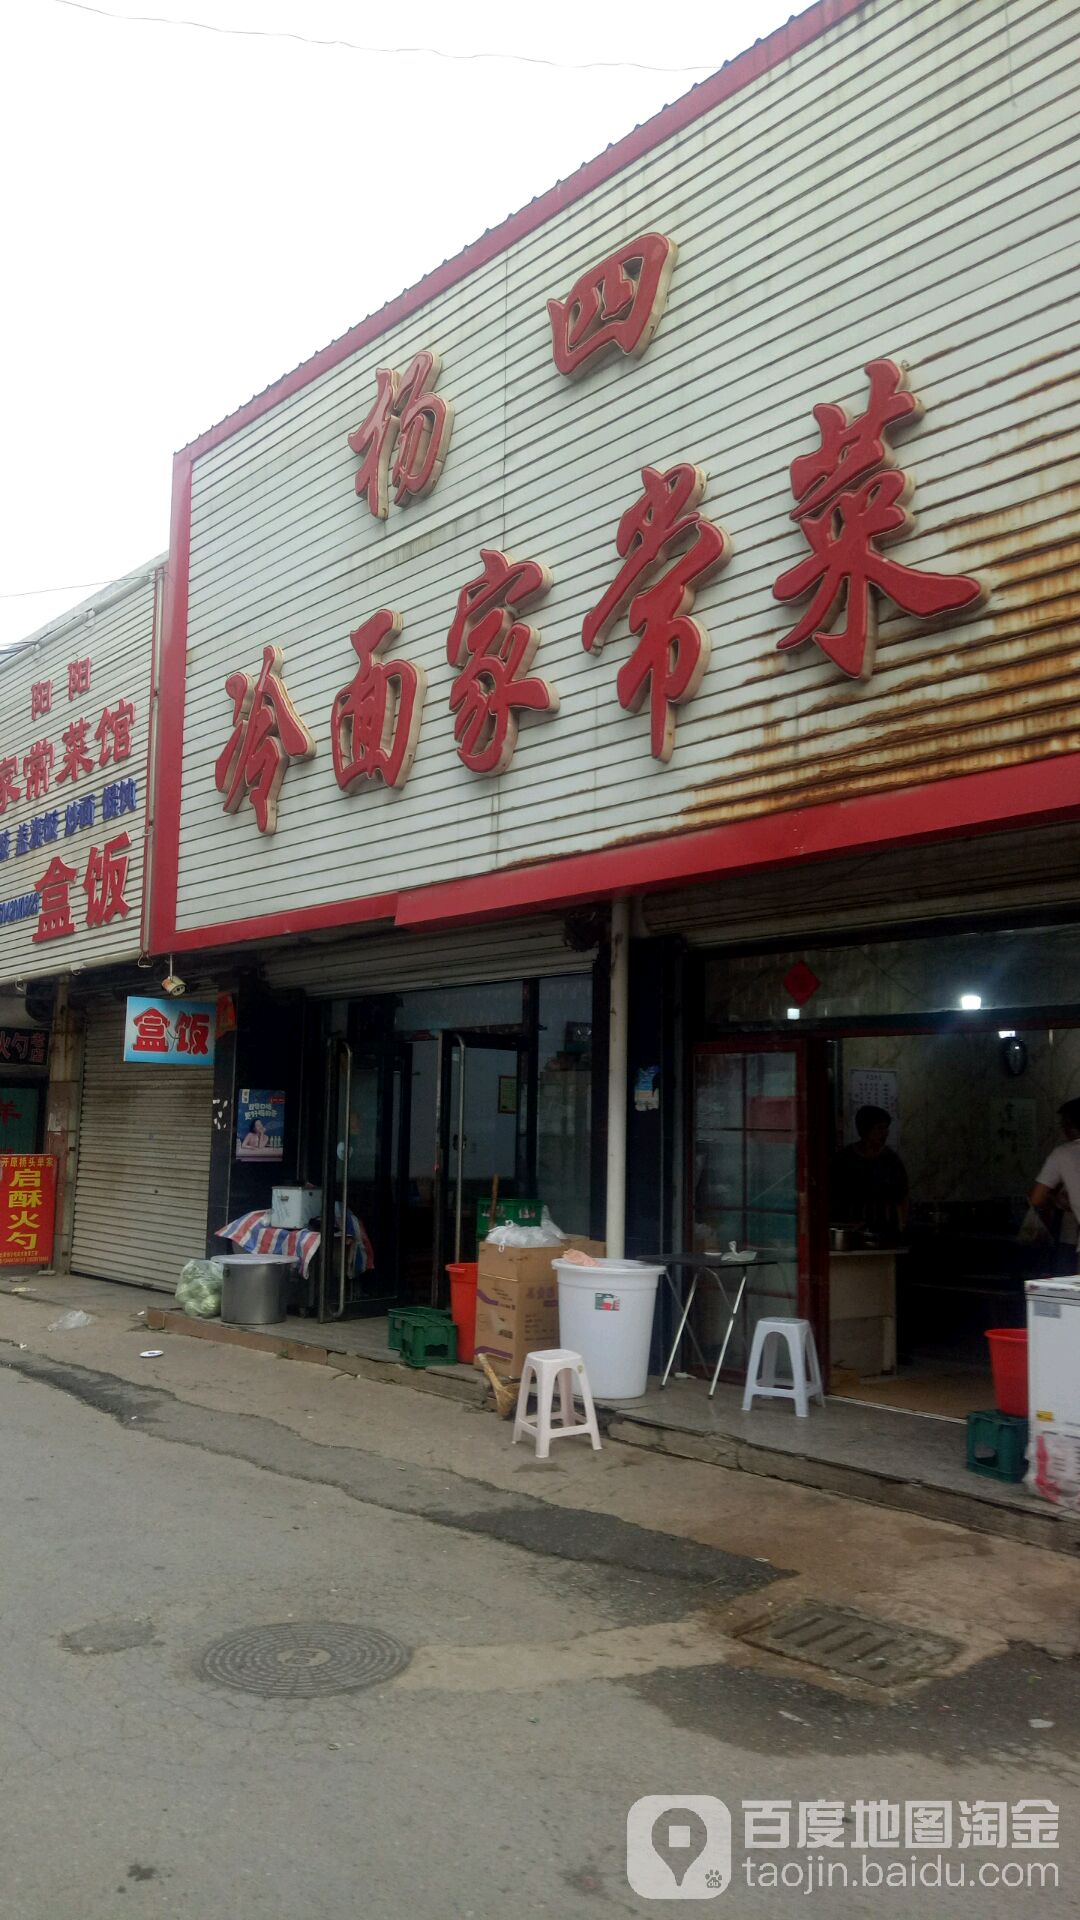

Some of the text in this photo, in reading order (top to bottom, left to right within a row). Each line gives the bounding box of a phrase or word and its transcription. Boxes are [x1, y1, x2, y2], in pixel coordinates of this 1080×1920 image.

[215, 358, 988, 836] 冷面家常菜
[32, 656, 92, 721] 阳阳
[32, 831, 132, 943] 盒饭
[132, 1006, 210, 1056] 盒饭
